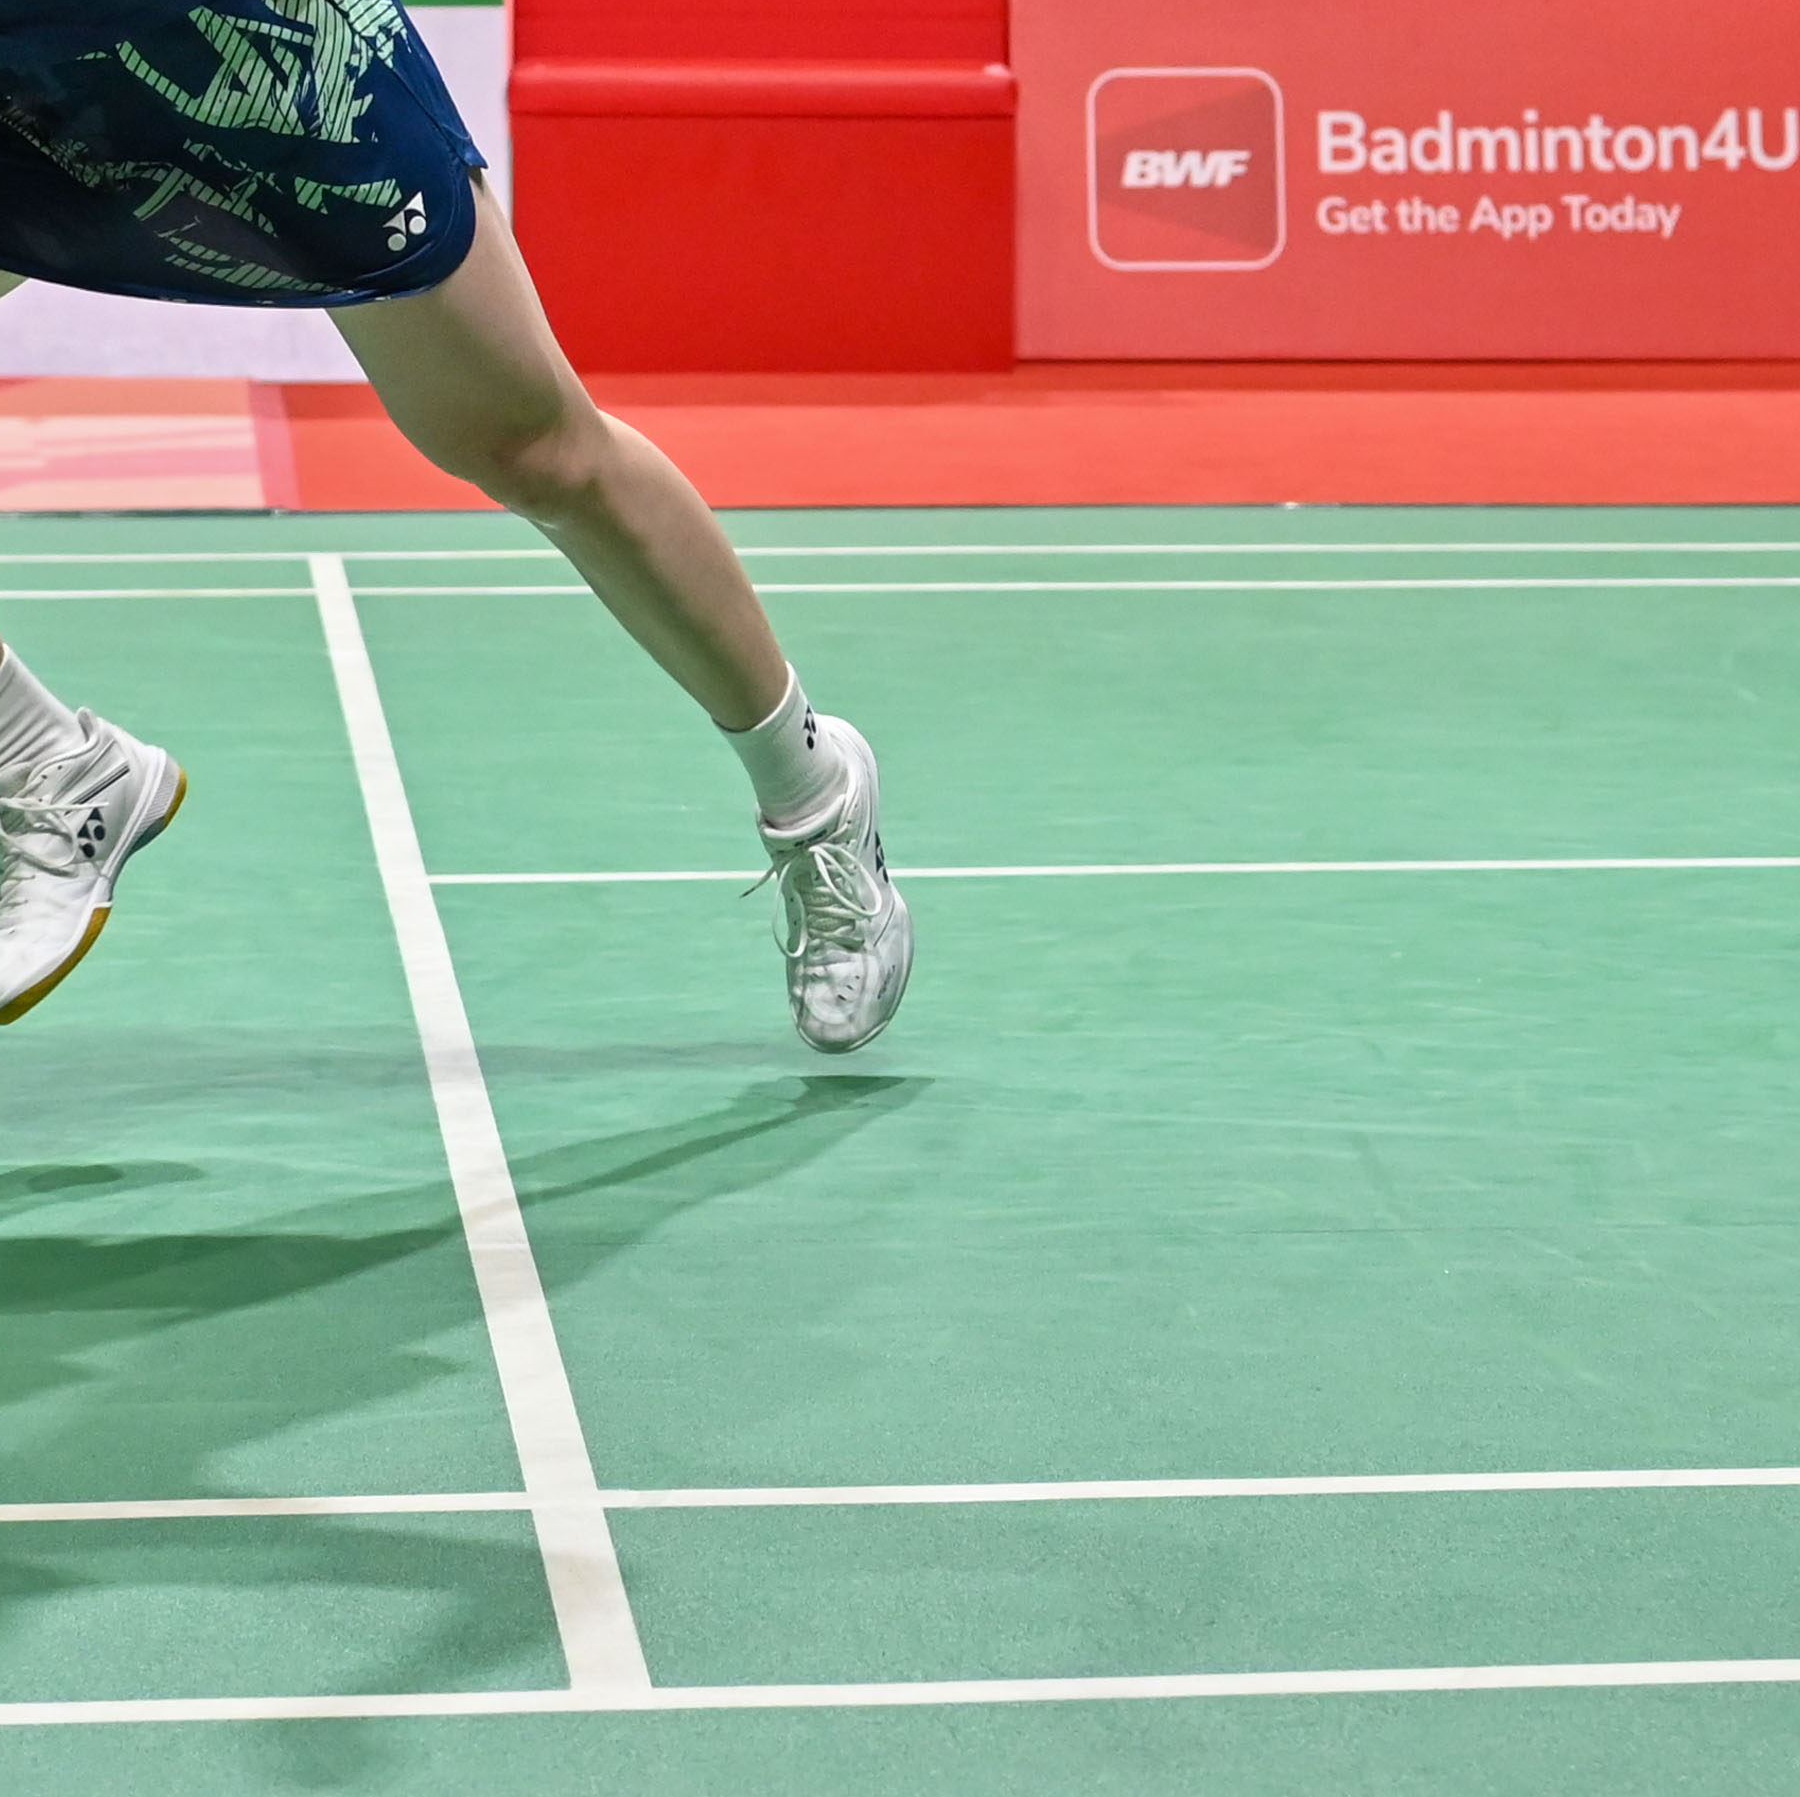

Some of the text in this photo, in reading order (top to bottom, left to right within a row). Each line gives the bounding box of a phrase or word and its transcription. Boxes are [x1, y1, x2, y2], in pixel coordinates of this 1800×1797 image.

[1317, 108, 1800, 173] Badminton4U
[1121, 150, 1250, 188] BWF
[1317, 195, 1683, 238] Get the App Today
